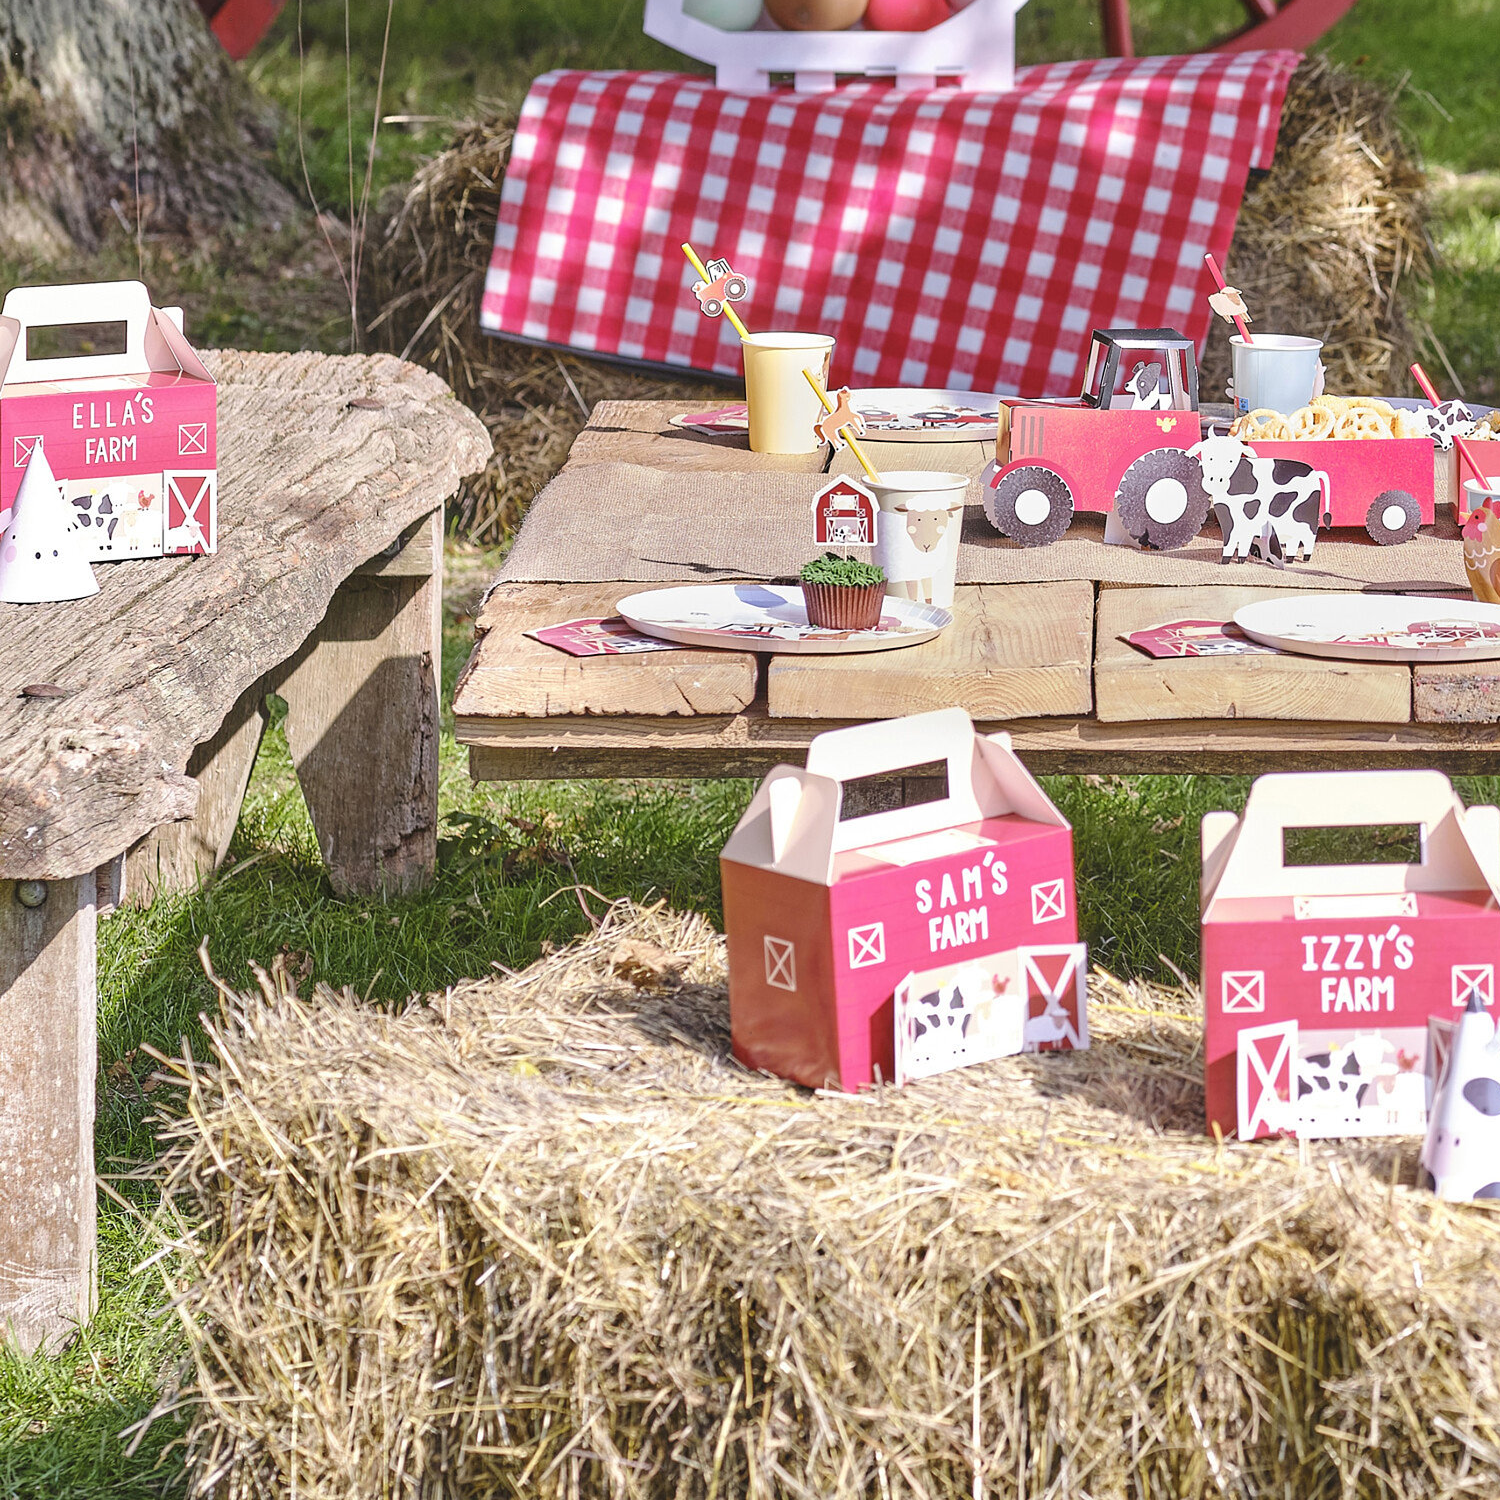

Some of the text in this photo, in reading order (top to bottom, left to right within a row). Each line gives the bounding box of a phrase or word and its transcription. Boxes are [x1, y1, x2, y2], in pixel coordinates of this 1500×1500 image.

[72, 391, 154, 429] ELLA'S
[85, 434, 137, 465] FARM
[915, 850, 1008, 914] SAM'S
[928, 905, 989, 953] FARM
[1301, 923, 1415, 972] IZZY'S
[1321, 975, 1395, 1014] FARM
